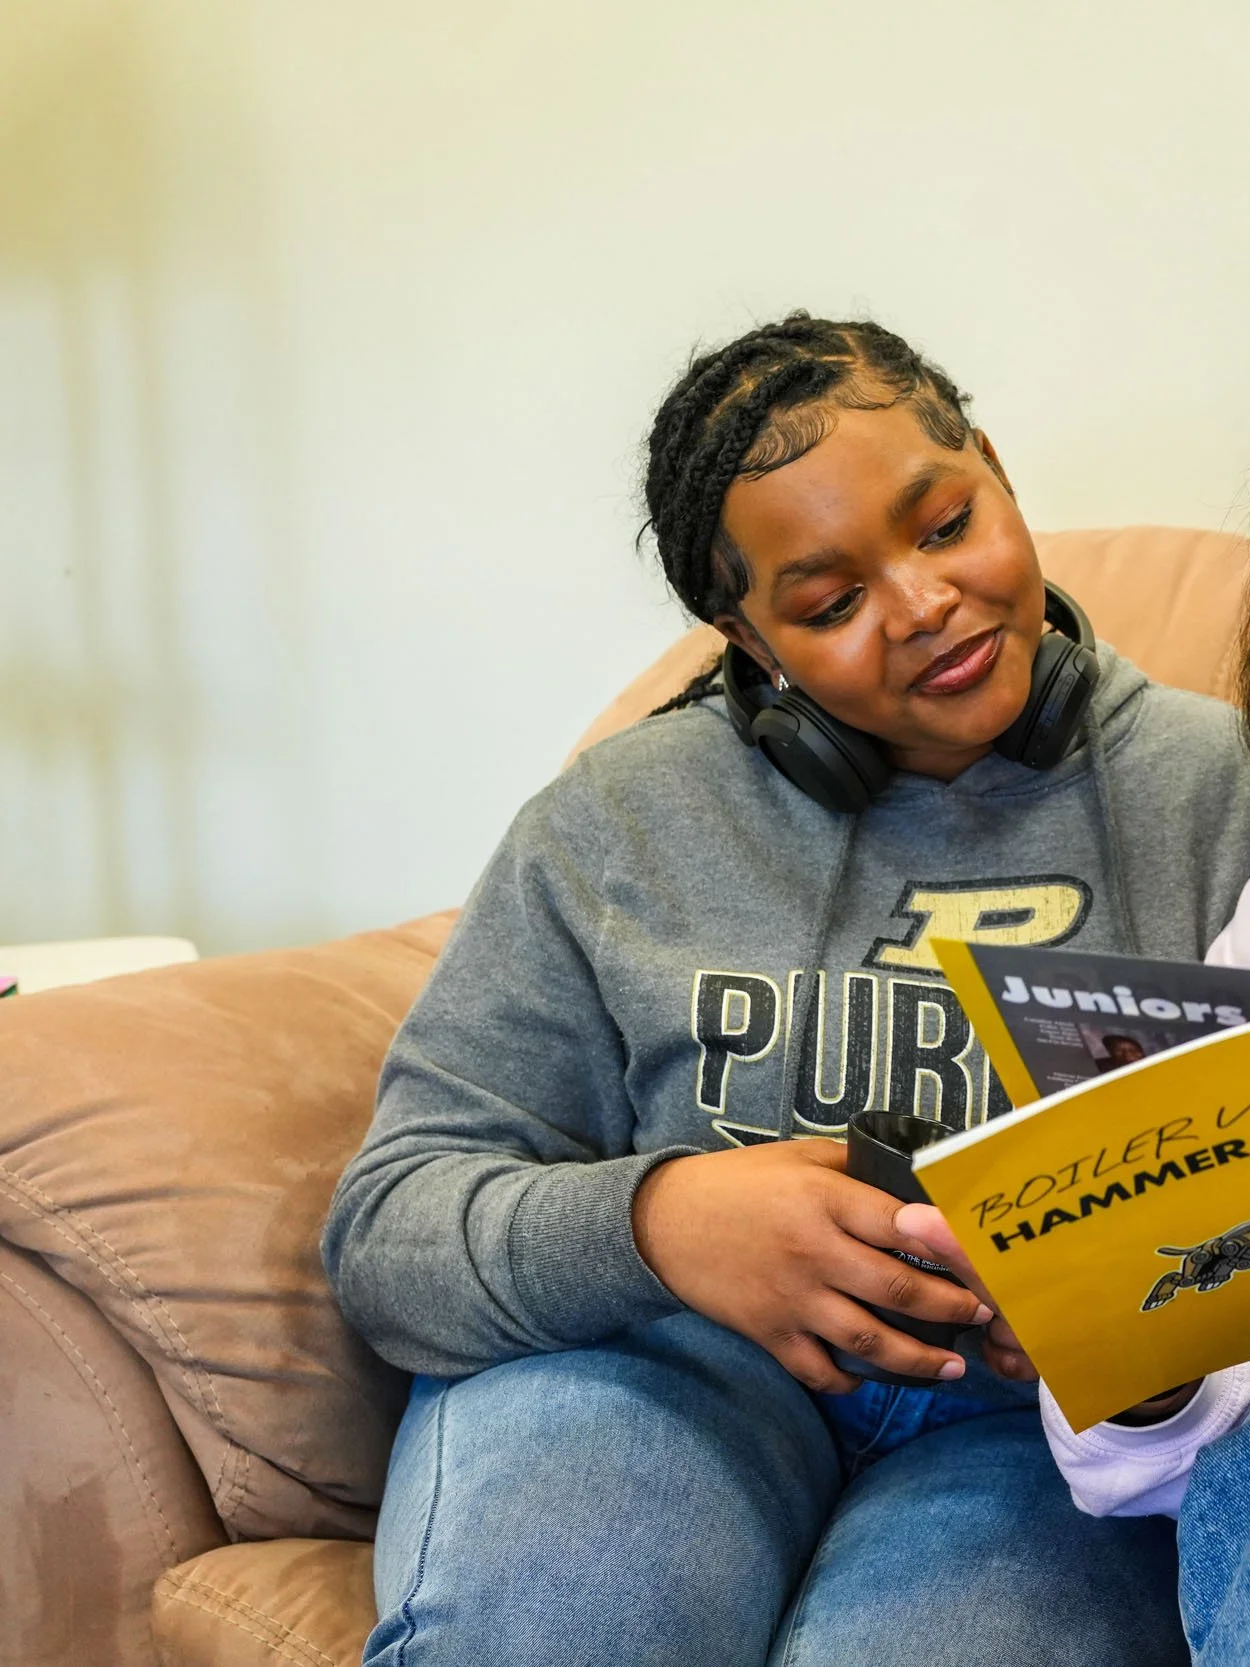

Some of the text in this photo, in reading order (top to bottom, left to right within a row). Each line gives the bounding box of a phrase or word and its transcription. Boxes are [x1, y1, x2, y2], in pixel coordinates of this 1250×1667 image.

[862, 874, 1093, 977] P
[691, 969, 1016, 1132] PUR
[1002, 976, 1246, 1026] Juniors
[971, 1117, 1198, 1228] BOILER
